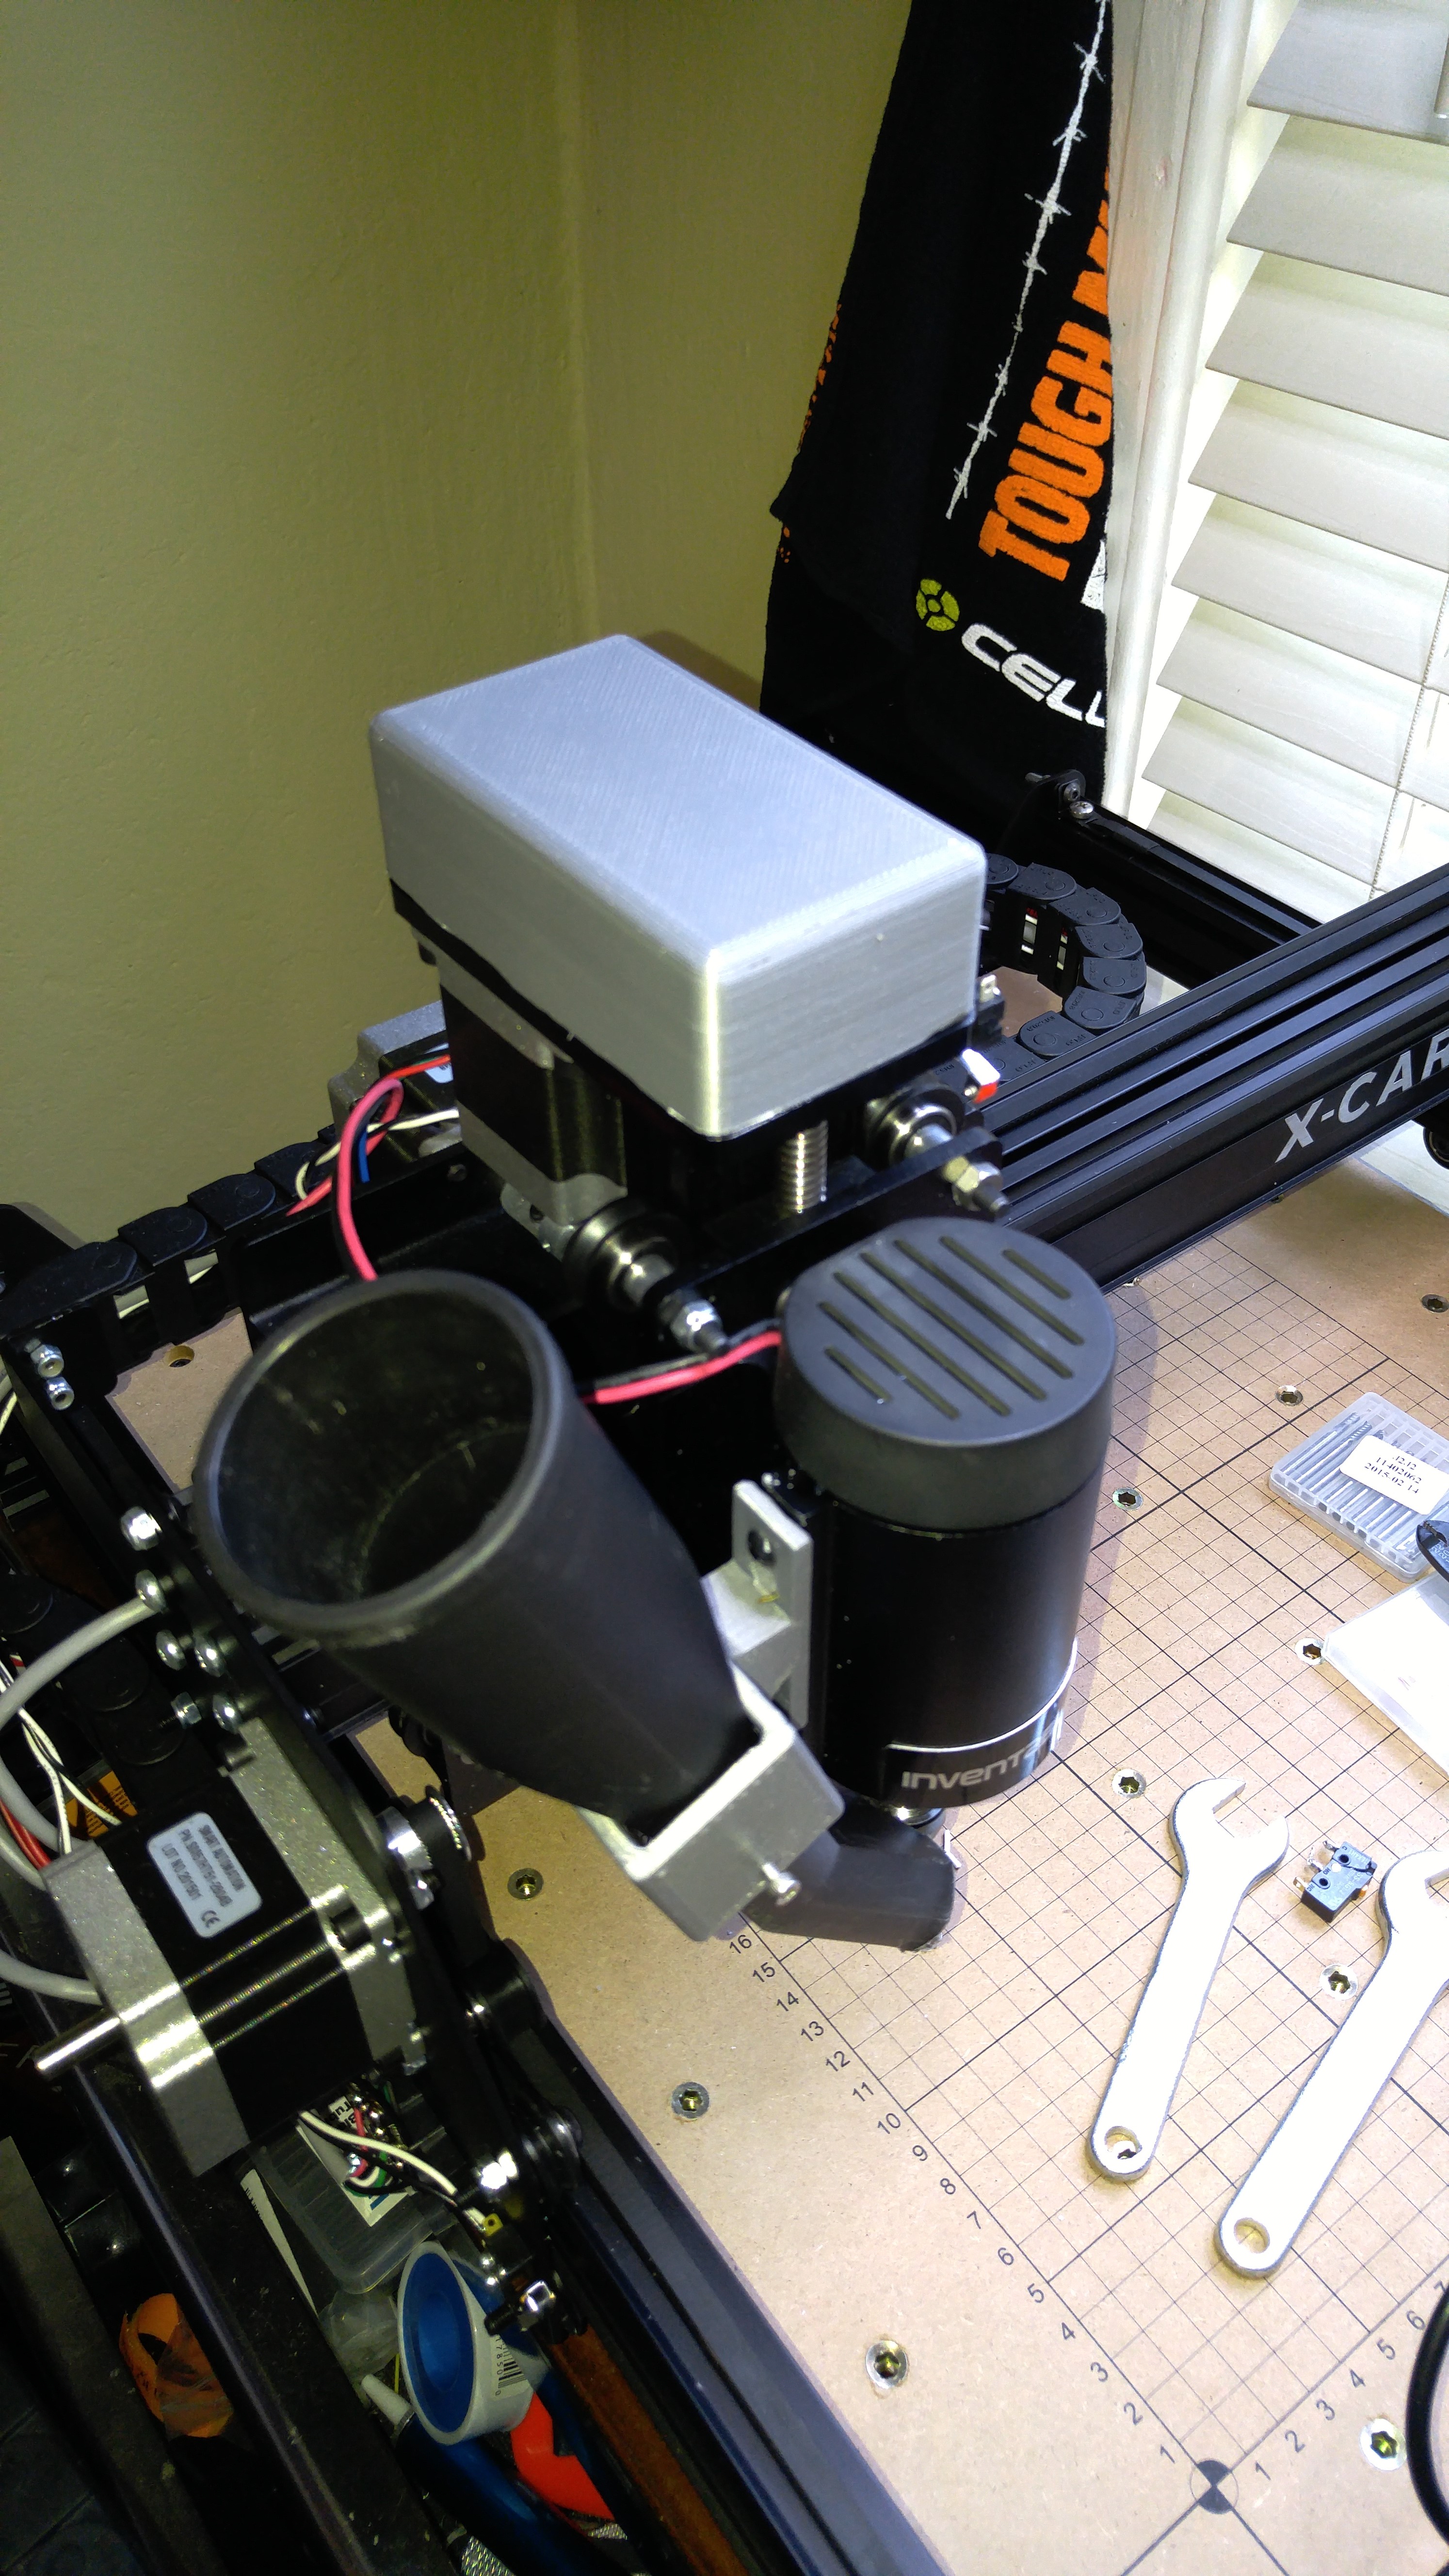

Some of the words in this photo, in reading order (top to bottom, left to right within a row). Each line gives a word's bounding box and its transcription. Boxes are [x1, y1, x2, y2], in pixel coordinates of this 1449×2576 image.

[979, 320, 1112, 582] TOUGH
[1274, 1029, 1449, 1164] X-CAR
[729, 1934, 752, 1954] 16
[753, 1962, 775, 1982] 15
[776, 1992, 799, 2012] 14
[801, 2021, 824, 2042] 13
[825, 2051, 851, 2072] 12
[853, 2082, 874, 2102] 11
[877, 2113, 901, 2134] 10
[912, 2145, 928, 2161] 9
[940, 2178, 956, 2195] 8
[966, 2210, 981, 2229] 7
[998, 2247, 1014, 2266] 6
[1027, 2283, 1044, 2303] 5
[1406, 2309, 1426, 2331] 6
[1061, 2322, 1076, 2340] 4
[1376, 2337, 1396, 2360] 5
[1090, 2362, 1109, 2382] 3
[1350, 2369, 1366, 2387] 4
[1124, 2402, 1143, 2426] 2
[1316, 2399, 1335, 2421] 3
[1285, 2430, 1305, 2453] 2
[1160, 2445, 1175, 2463] 1
[1255, 2461, 1271, 2480] 1
